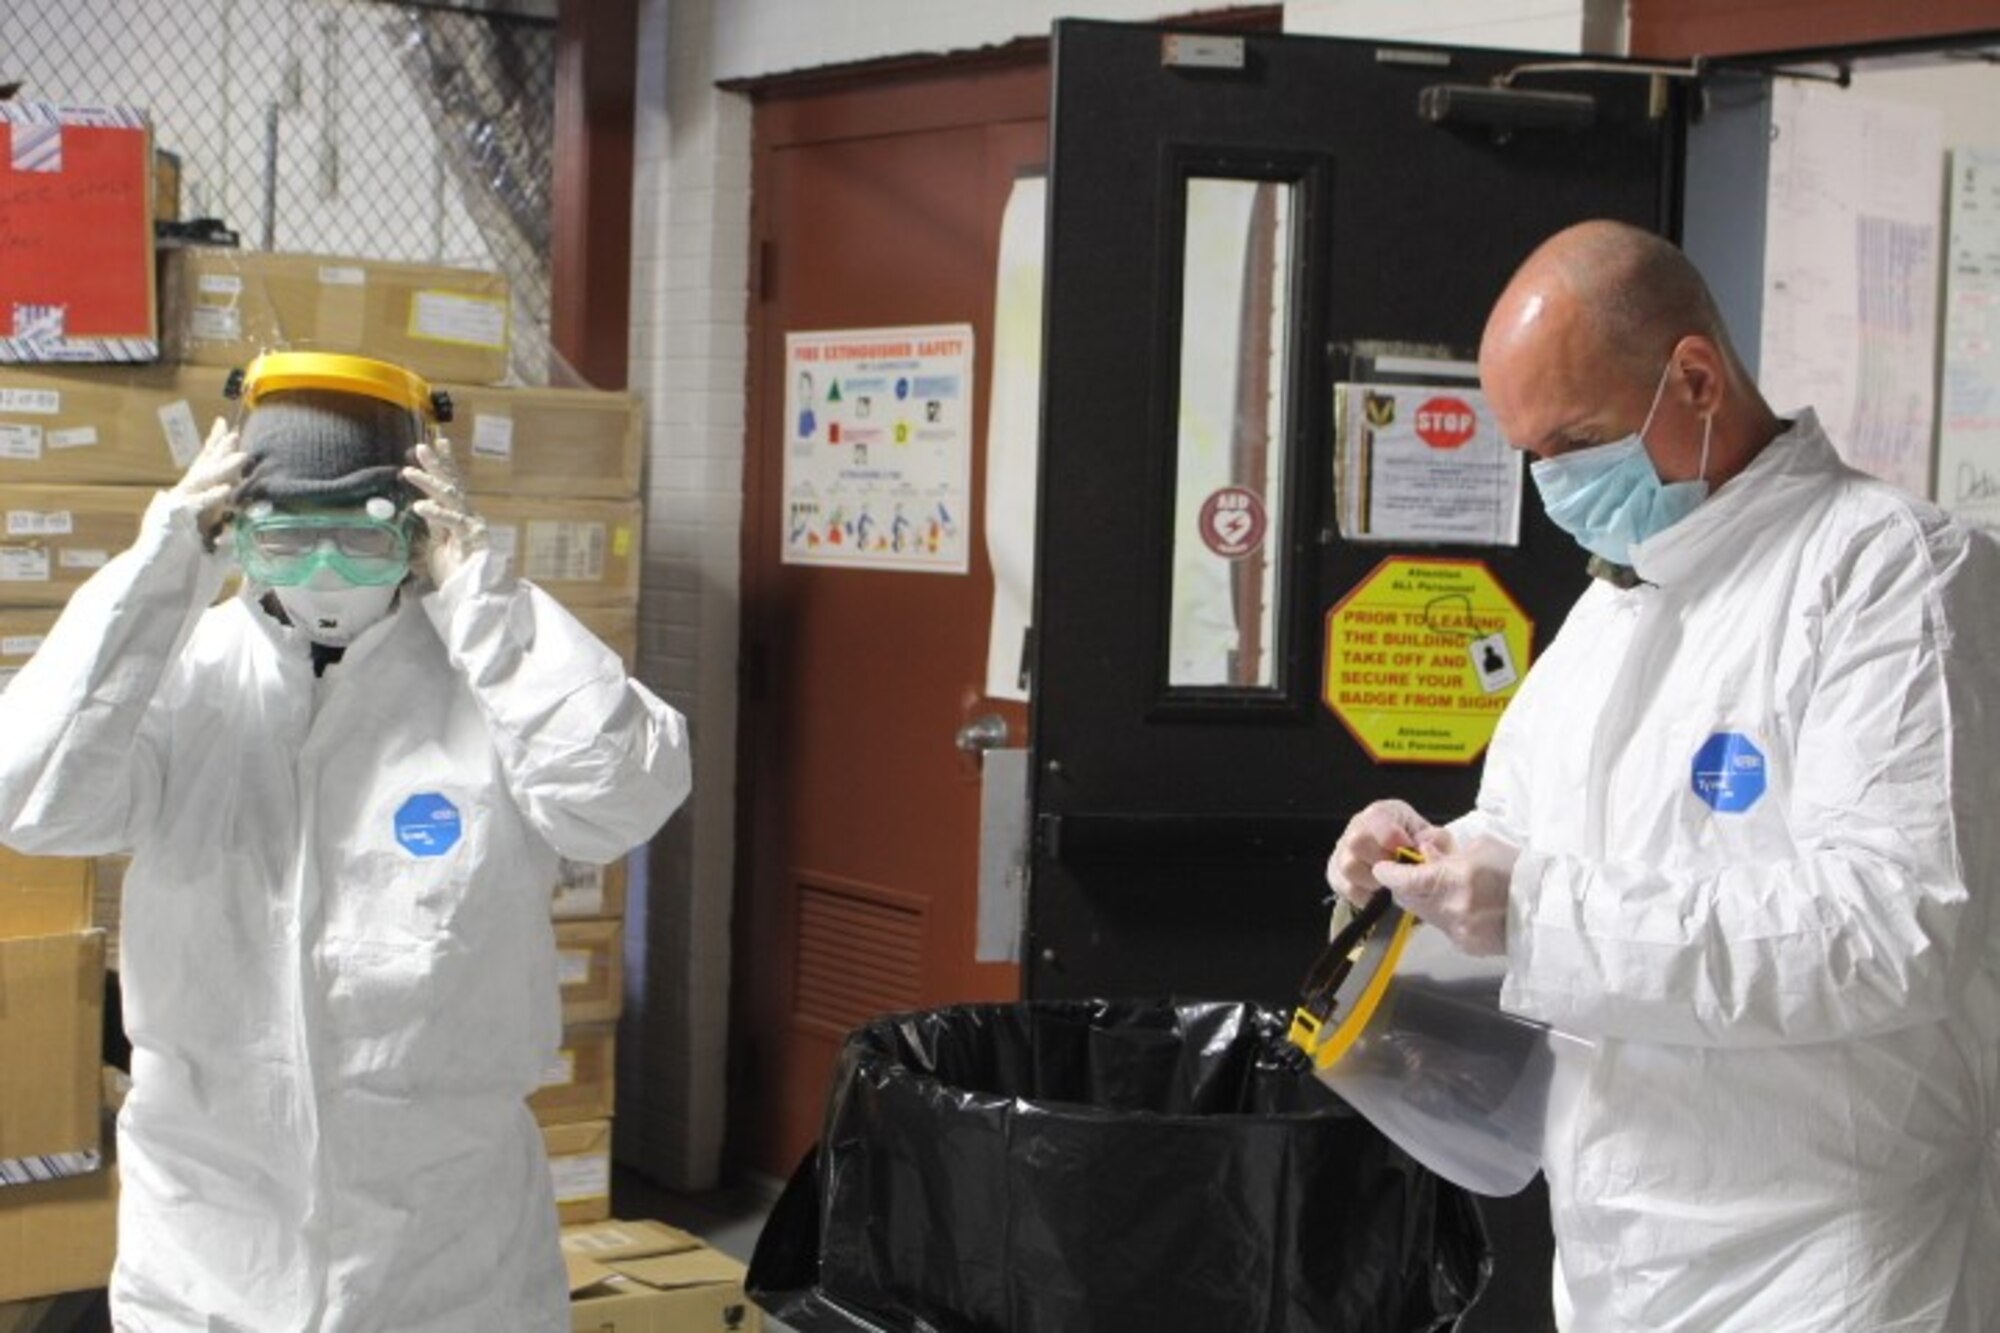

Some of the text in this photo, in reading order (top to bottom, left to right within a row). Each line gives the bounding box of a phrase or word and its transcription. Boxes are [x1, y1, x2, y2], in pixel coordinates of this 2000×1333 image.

[918, 340, 962, 357] SAFETY
[1417, 412, 1472, 433] STOP
[1216, 493, 1250, 509] AED
[1408, 568, 1461, 579] Attention
[1392, 581, 1475, 593] ALL Personnel
[1344, 611, 1506, 629] PRIOR TO LEAVING
[1343, 631, 1466, 648] THE BUILDING
[1342, 651, 1466, 668] TAKE OFF AND
[1341, 671, 1463, 688] SECURE YOUR
[1340, 691, 1398, 707] BADGE
[1404, 693, 1453, 709] FROM
[1398, 727, 1451, 738] Attention
[1383, 740, 1465, 752] ALL Personnel
